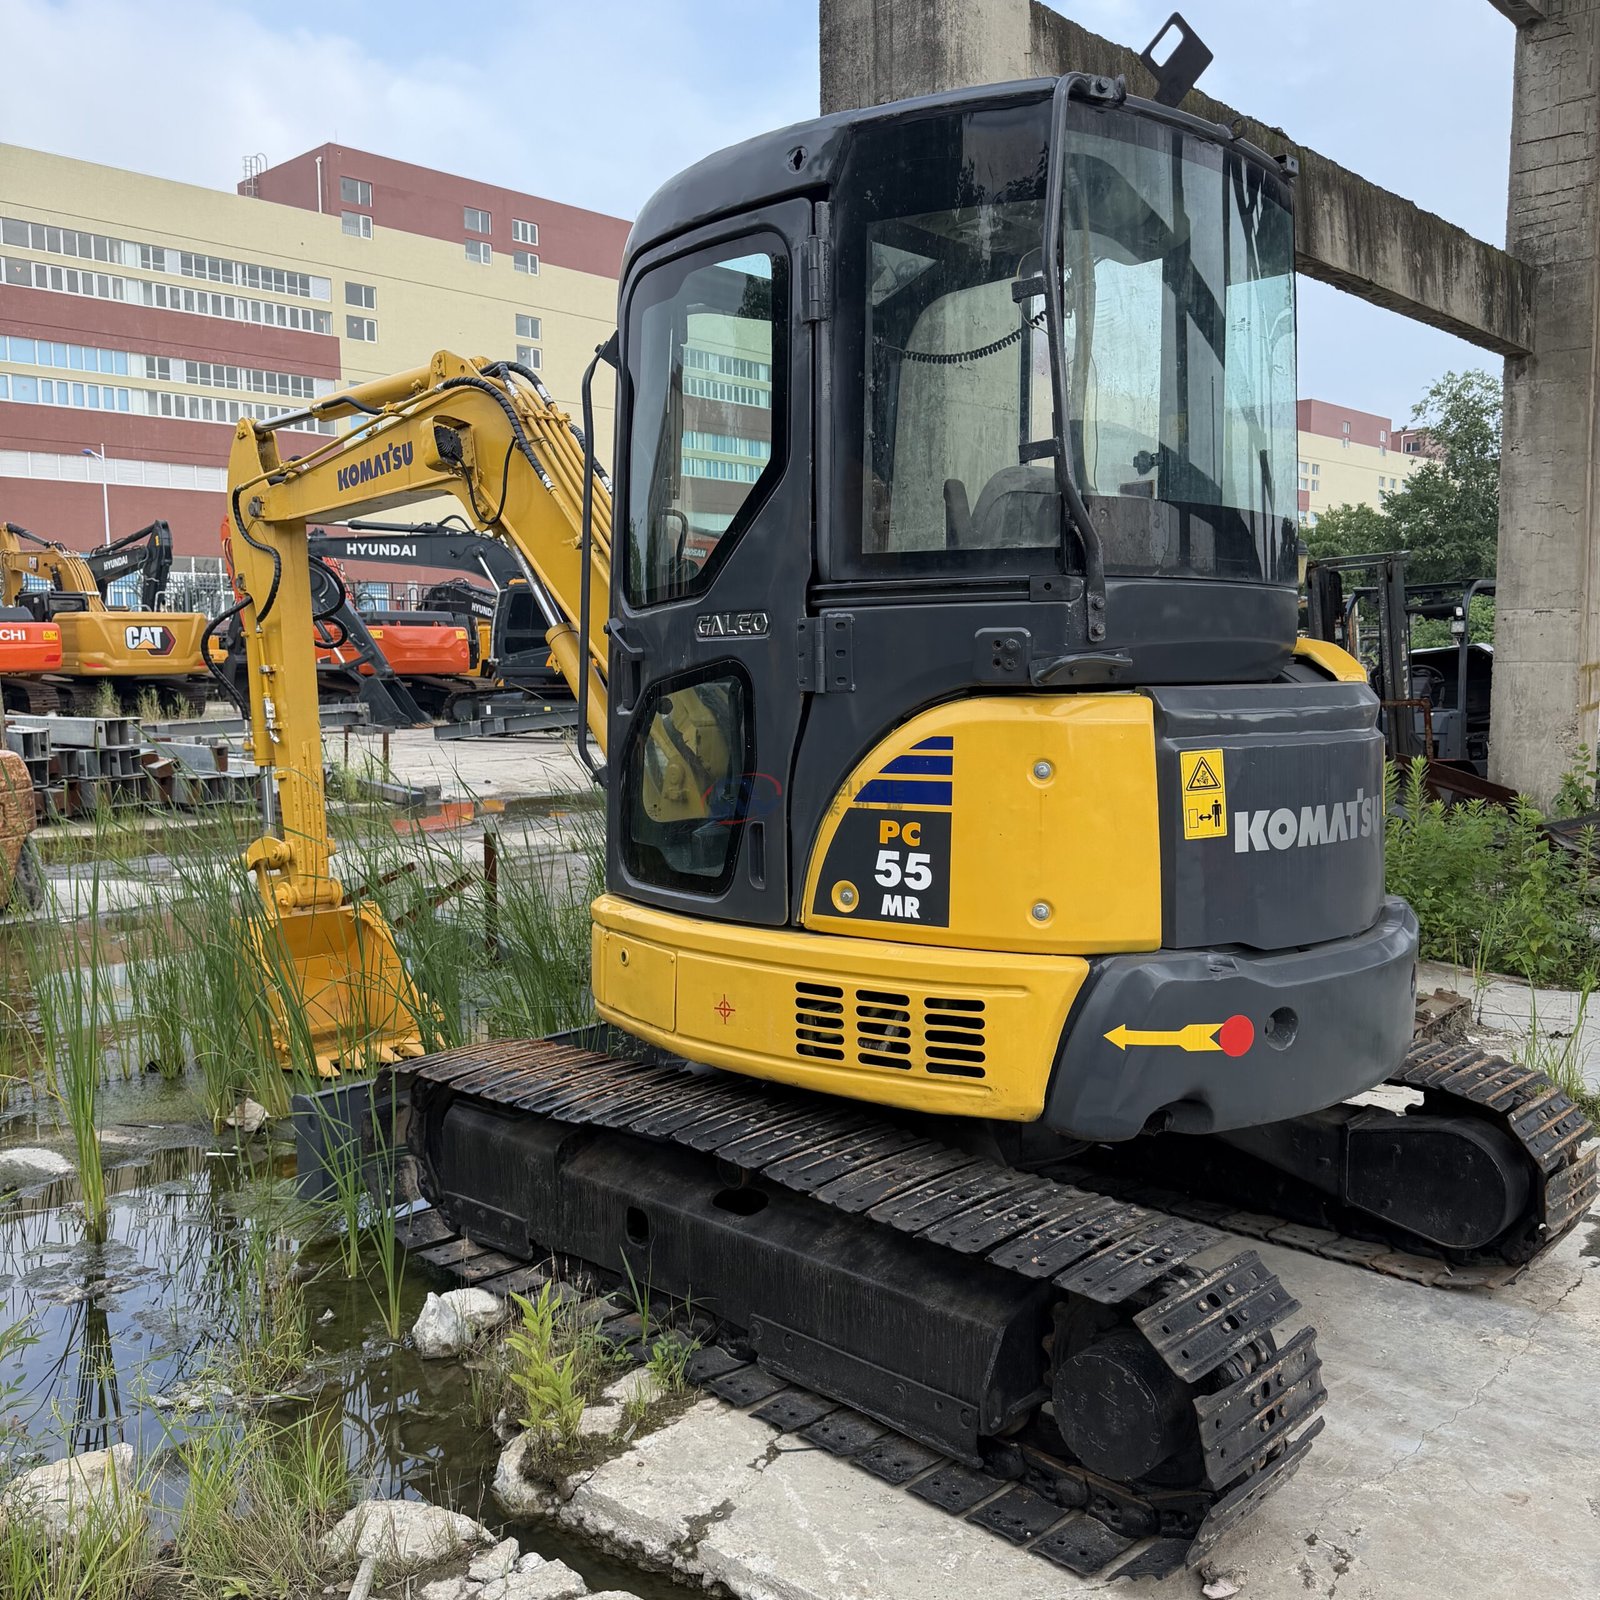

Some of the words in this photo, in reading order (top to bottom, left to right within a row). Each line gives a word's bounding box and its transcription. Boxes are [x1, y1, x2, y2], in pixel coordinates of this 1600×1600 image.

[337, 441, 414, 491] KOMATSU
[346, 543, 417, 557] HYUNDAI
[103, 554, 129, 571] HYUNDAI
[697, 612, 769, 636] GALEO
[125, 626, 163, 649] CAT
[879, 820, 921, 846] PC
[1234, 788, 1381, 854] KOMATSU
[874, 850, 932, 891] 55
[881, 895, 920, 919] MR
